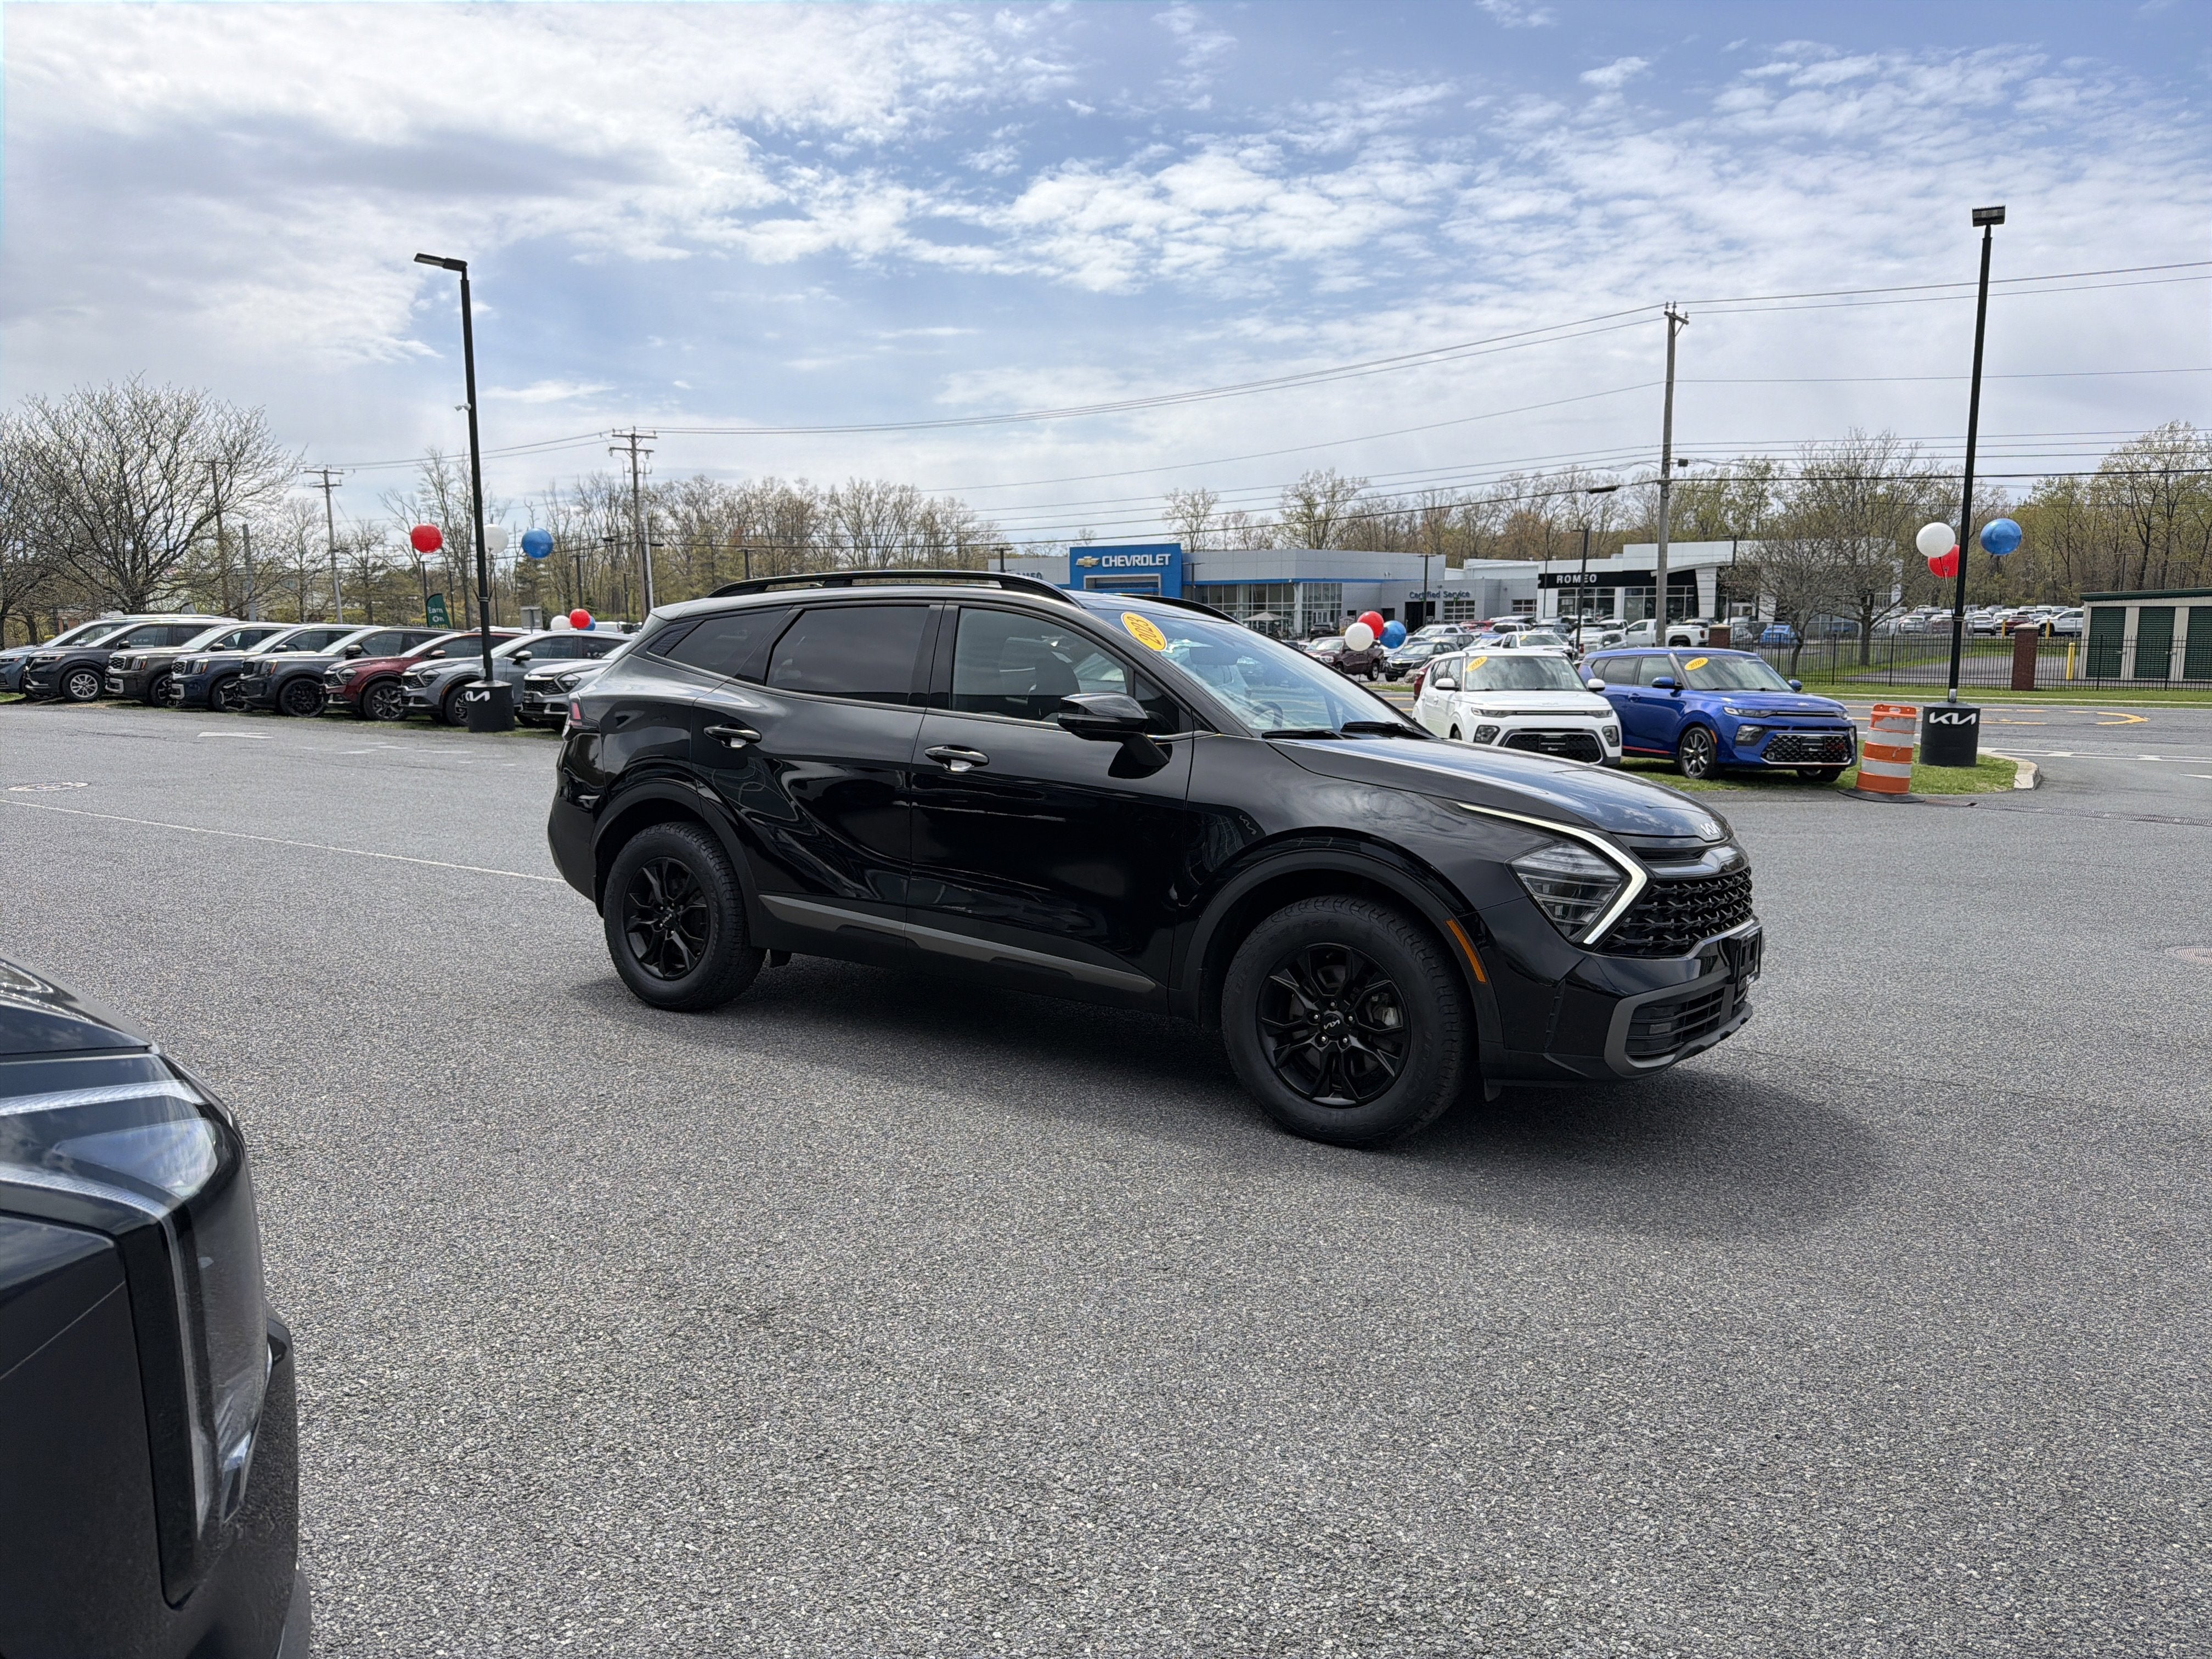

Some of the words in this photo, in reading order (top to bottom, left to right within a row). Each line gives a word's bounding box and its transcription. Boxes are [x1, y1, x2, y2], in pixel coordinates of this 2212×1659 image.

[1102, 554, 1171, 567] CHEVROLET
[1126, 616, 1163, 646] 2023
[1929, 712, 1977, 725] KIA
